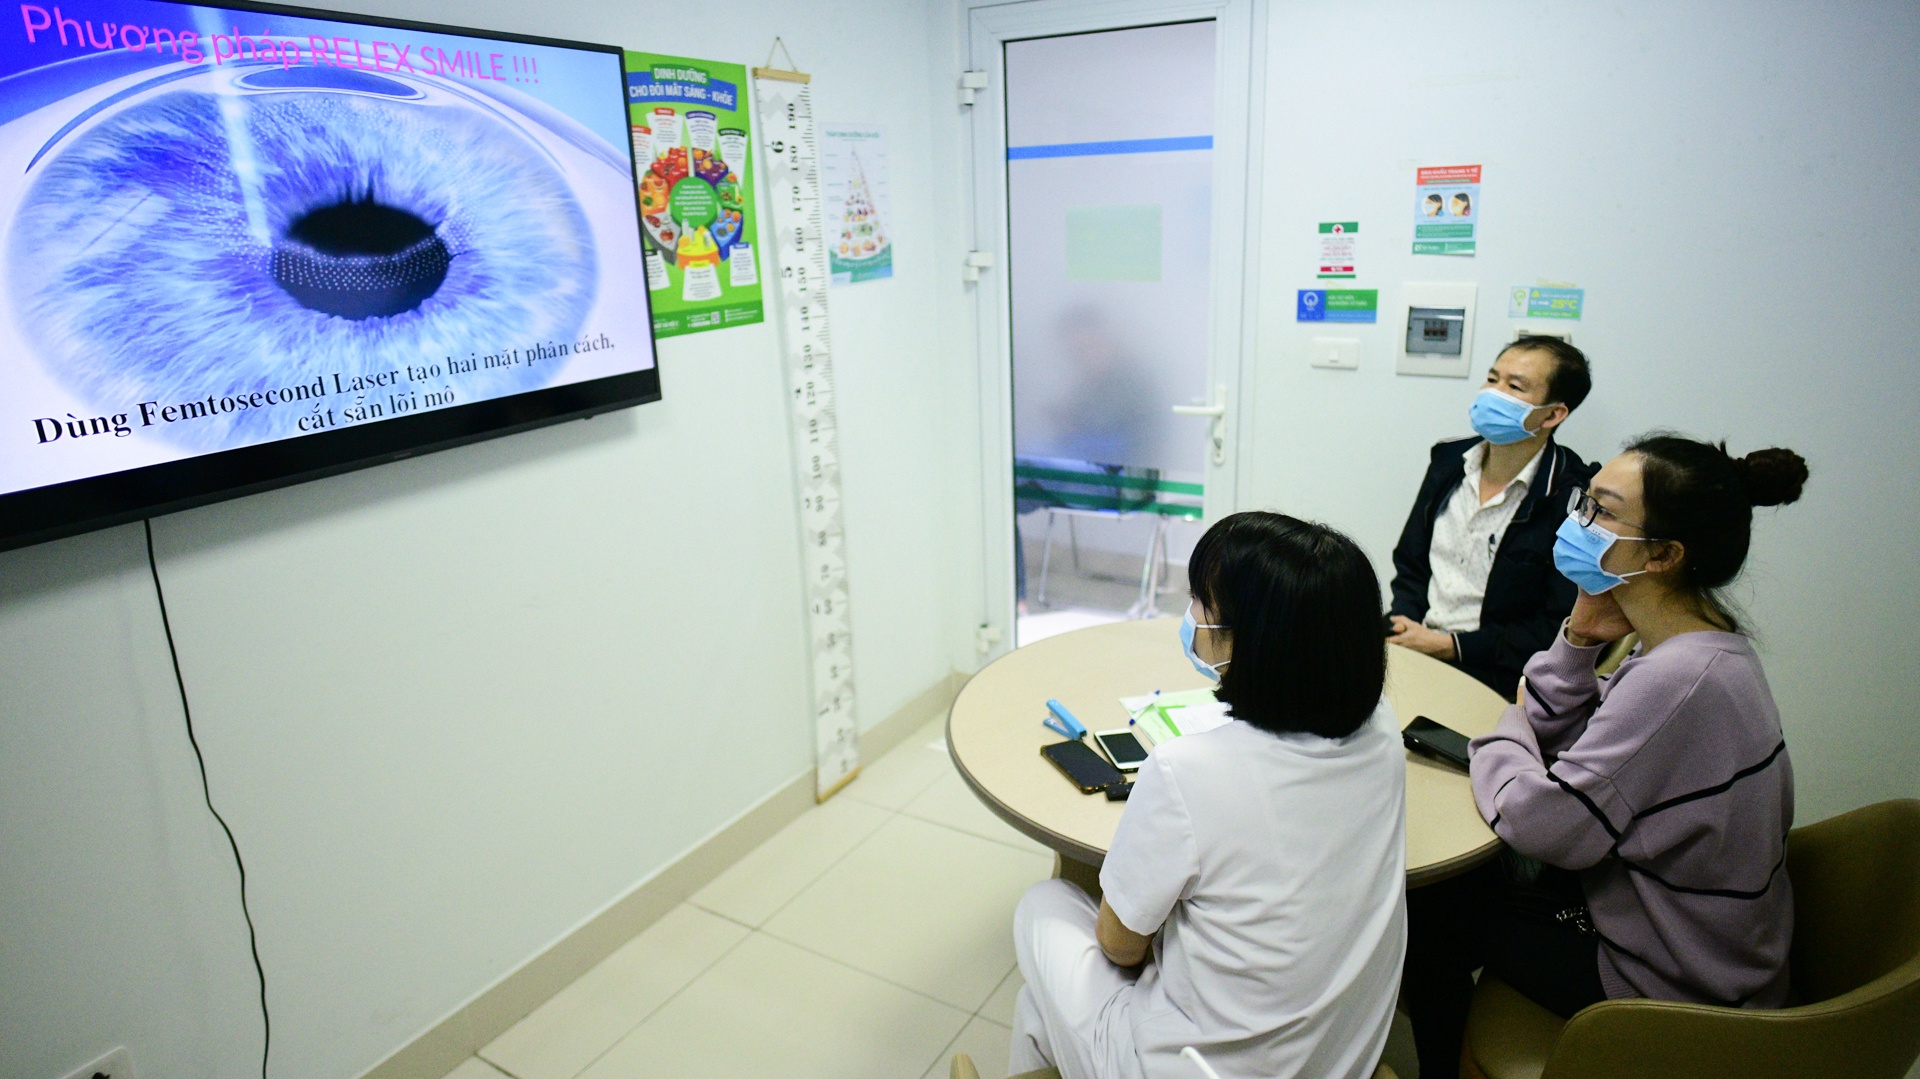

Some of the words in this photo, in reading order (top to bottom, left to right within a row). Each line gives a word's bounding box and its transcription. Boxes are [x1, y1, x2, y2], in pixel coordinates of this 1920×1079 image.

[20, 4, 204, 64] Phương
[211, 25, 300, 70] pháp
[308, 34, 415, 74] RELEX
[420, 45, 507, 81] SMILE
[513, 55, 539, 84] !!!
[654, 67, 676, 80] DINH
[629, 85, 648, 98] CHO
[649, 82, 665, 96] ĐÔI
[684, 84, 707, 99] SÁNG
[787, 102, 796, 130] 190
[771, 140, 784, 154] 6
[789, 145, 799, 171] 180
[792, 185, 801, 212] 170
[795, 227, 804, 253] 160
[781, 266, 793, 278] 5
[798, 267, 807, 293] 150
[803, 344, 813, 370] 130
[31, 412, 132, 445] Dùng
[136, 375, 327, 427] Femtosecond
[332, 369, 399, 396] Laser
[407, 364, 441, 385] tạo
[446, 353, 478, 376] hai
[483, 346, 520, 370] mặt
[526, 338, 569, 367] phân
[573, 332, 615, 355] cách,
[297, 402, 335, 432] cắt
[343, 393, 384, 424] sẵn
[390, 392, 418, 415] lõi
[423, 385, 455, 406] mô
